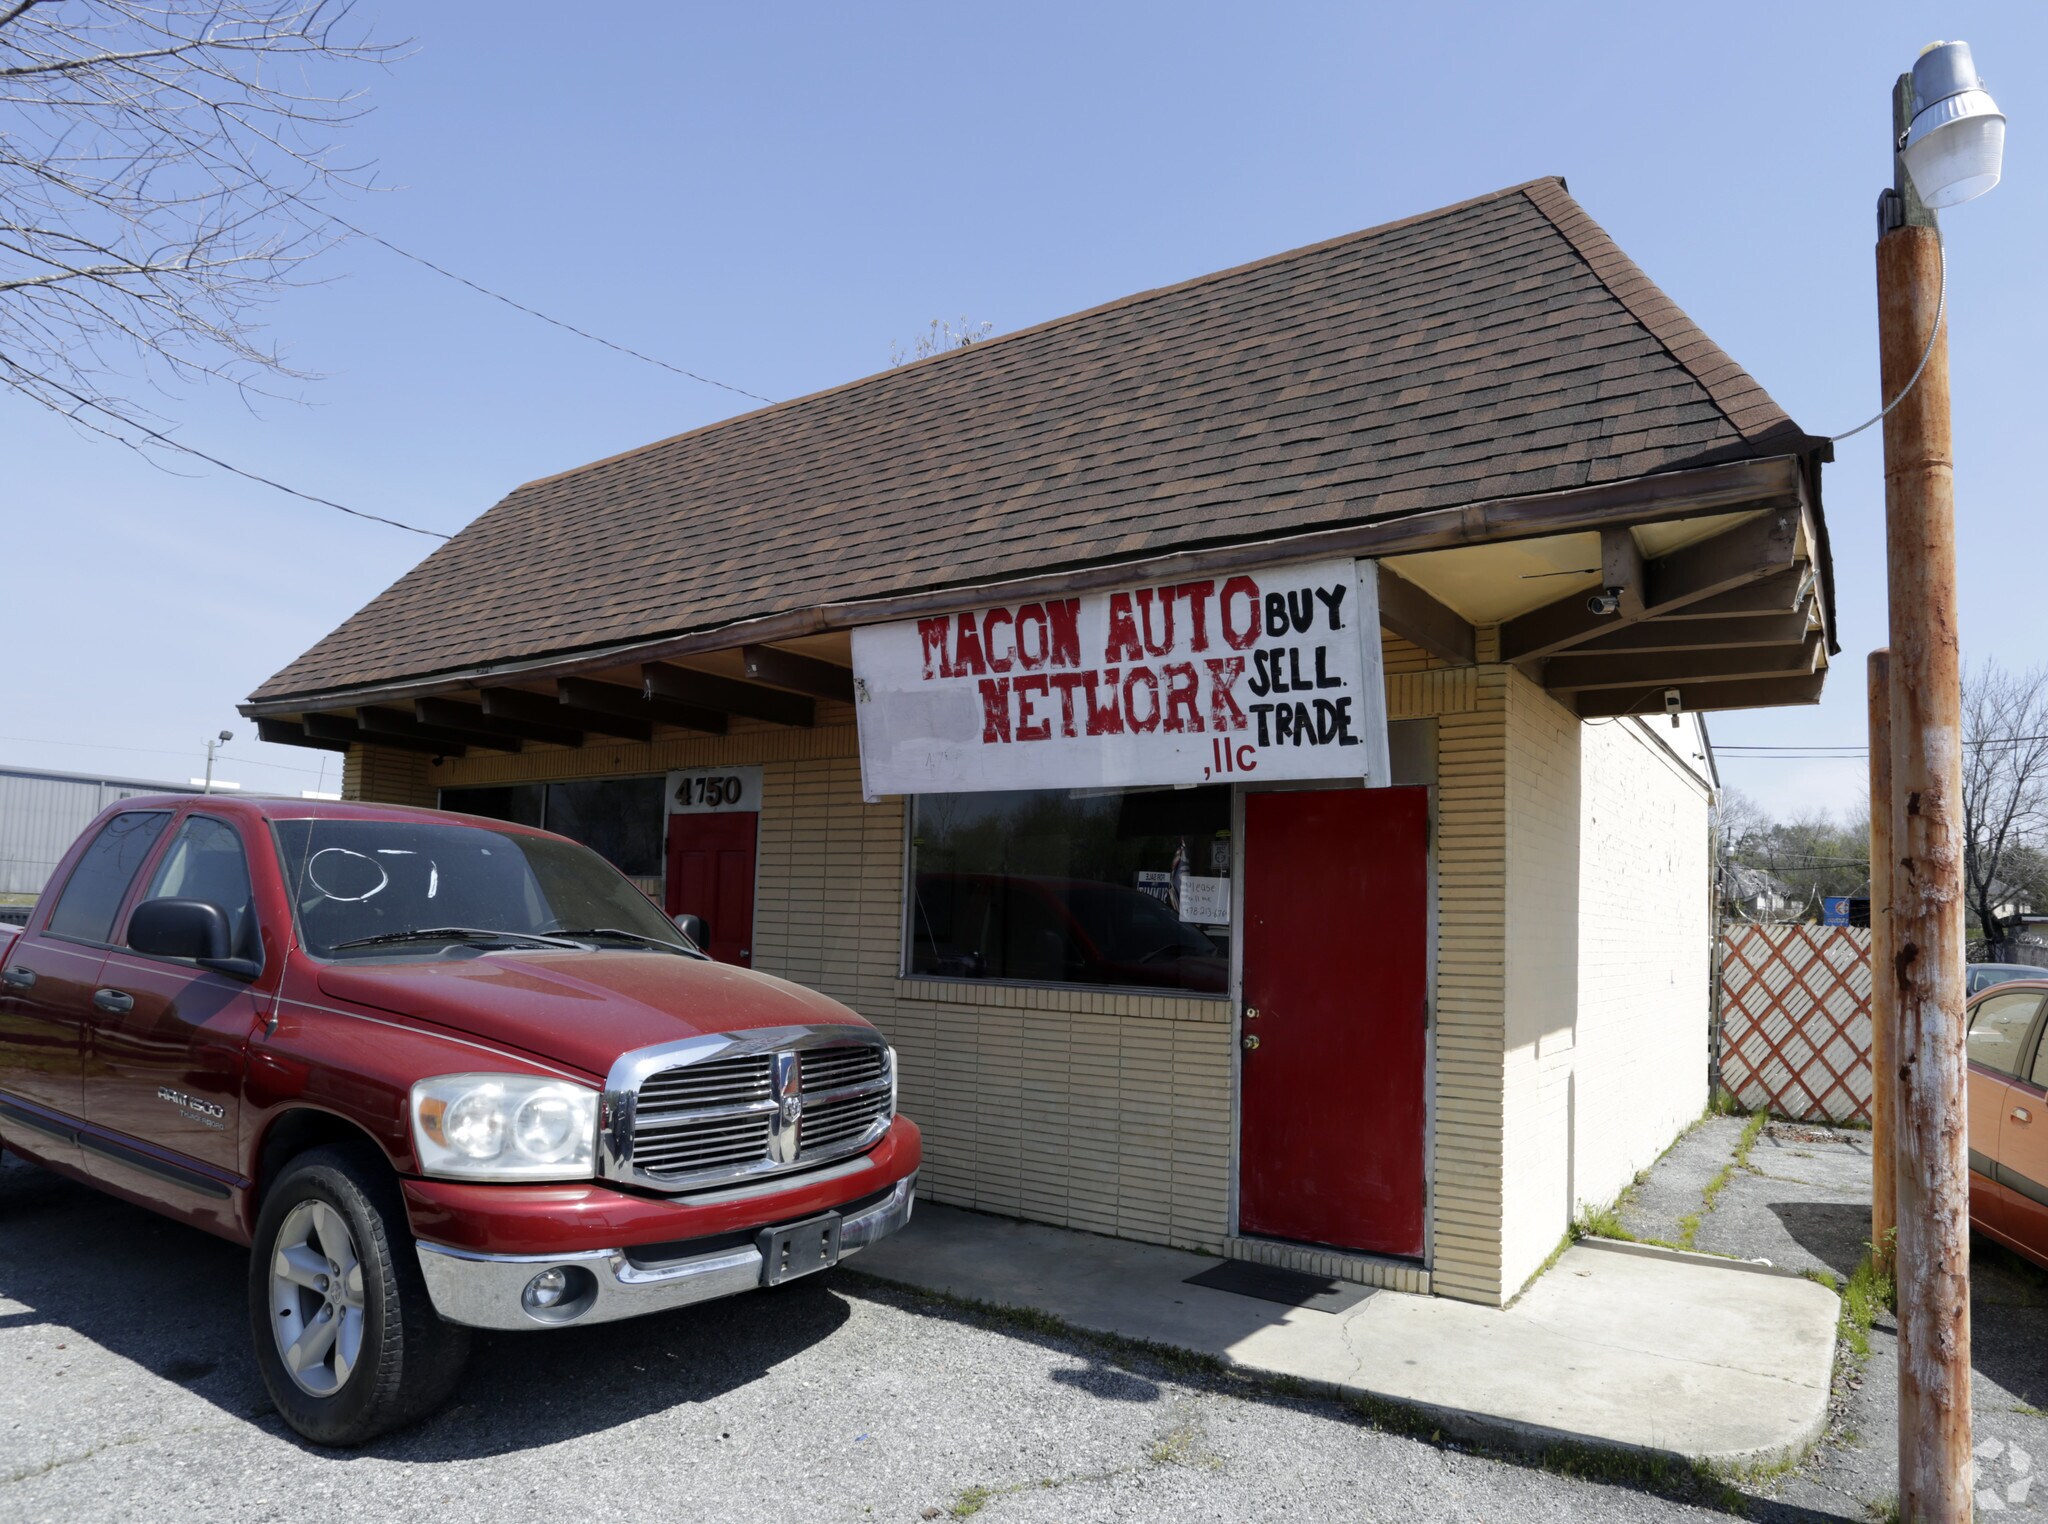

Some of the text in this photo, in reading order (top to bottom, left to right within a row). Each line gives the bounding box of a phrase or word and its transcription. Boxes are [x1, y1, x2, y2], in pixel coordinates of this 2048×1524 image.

[917, 575, 1262, 680] MACON AUTO
[978, 656, 1249, 744] NETWORK
[674, 776, 742, 806] 4750
[158, 1086, 188, 1106] RAM
